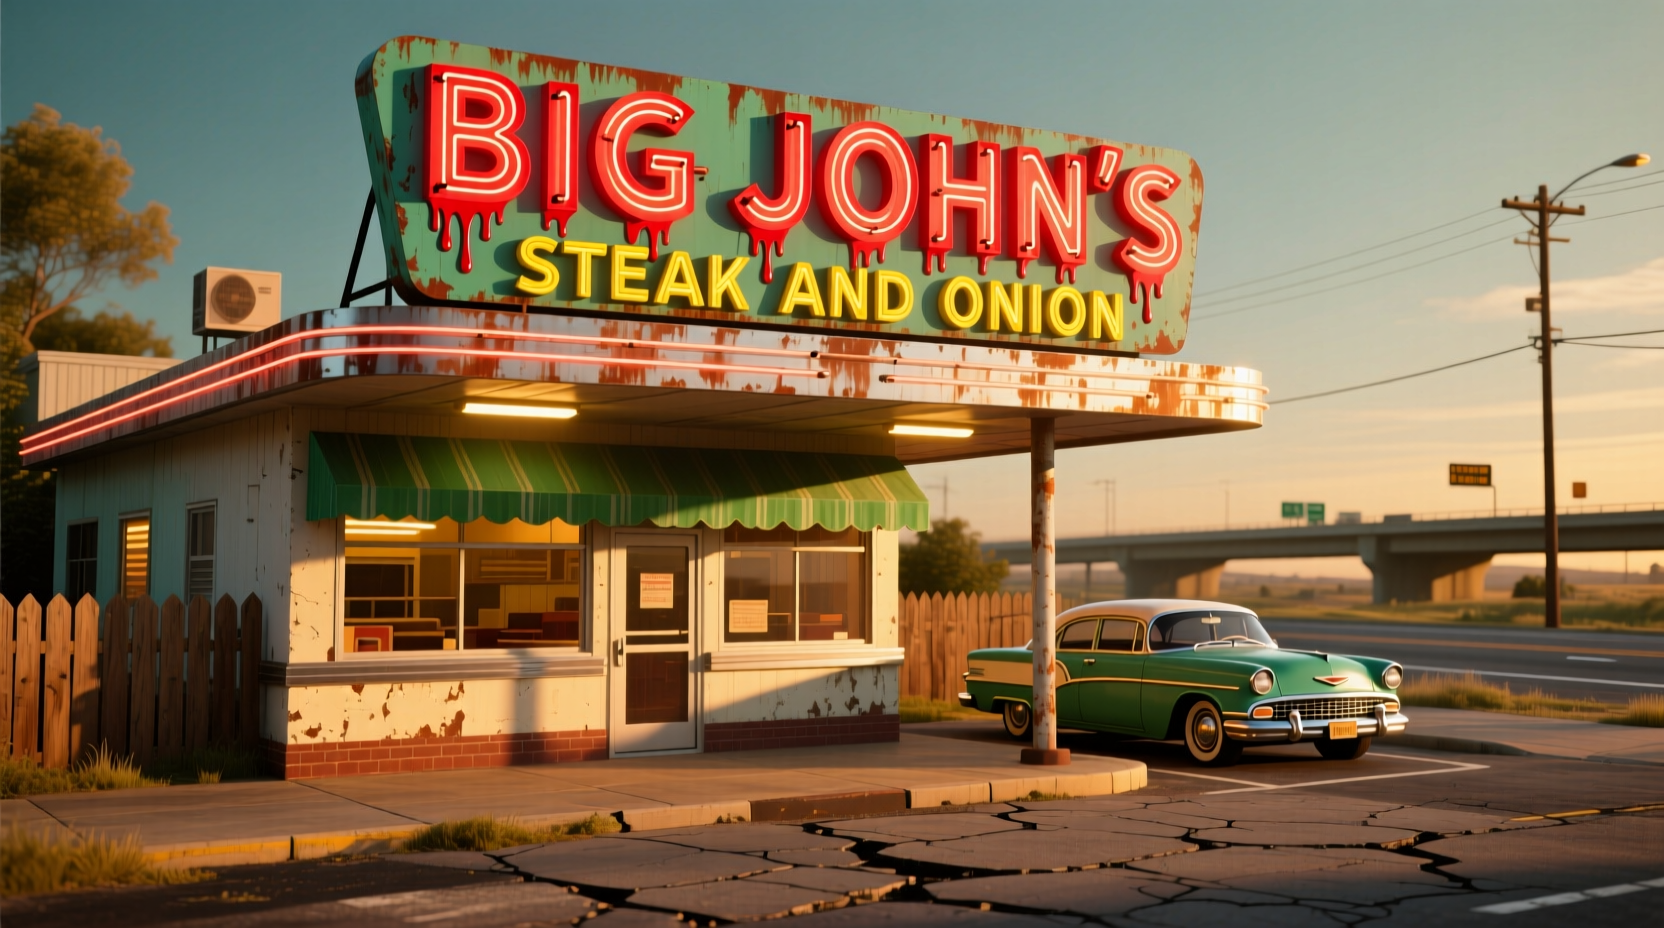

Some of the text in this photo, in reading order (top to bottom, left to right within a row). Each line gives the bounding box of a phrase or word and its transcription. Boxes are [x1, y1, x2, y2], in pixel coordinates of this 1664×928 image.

[423, 63, 1183, 275] BIG JOHN'S
[516, 235, 1124, 341] STEAK AND ONION
